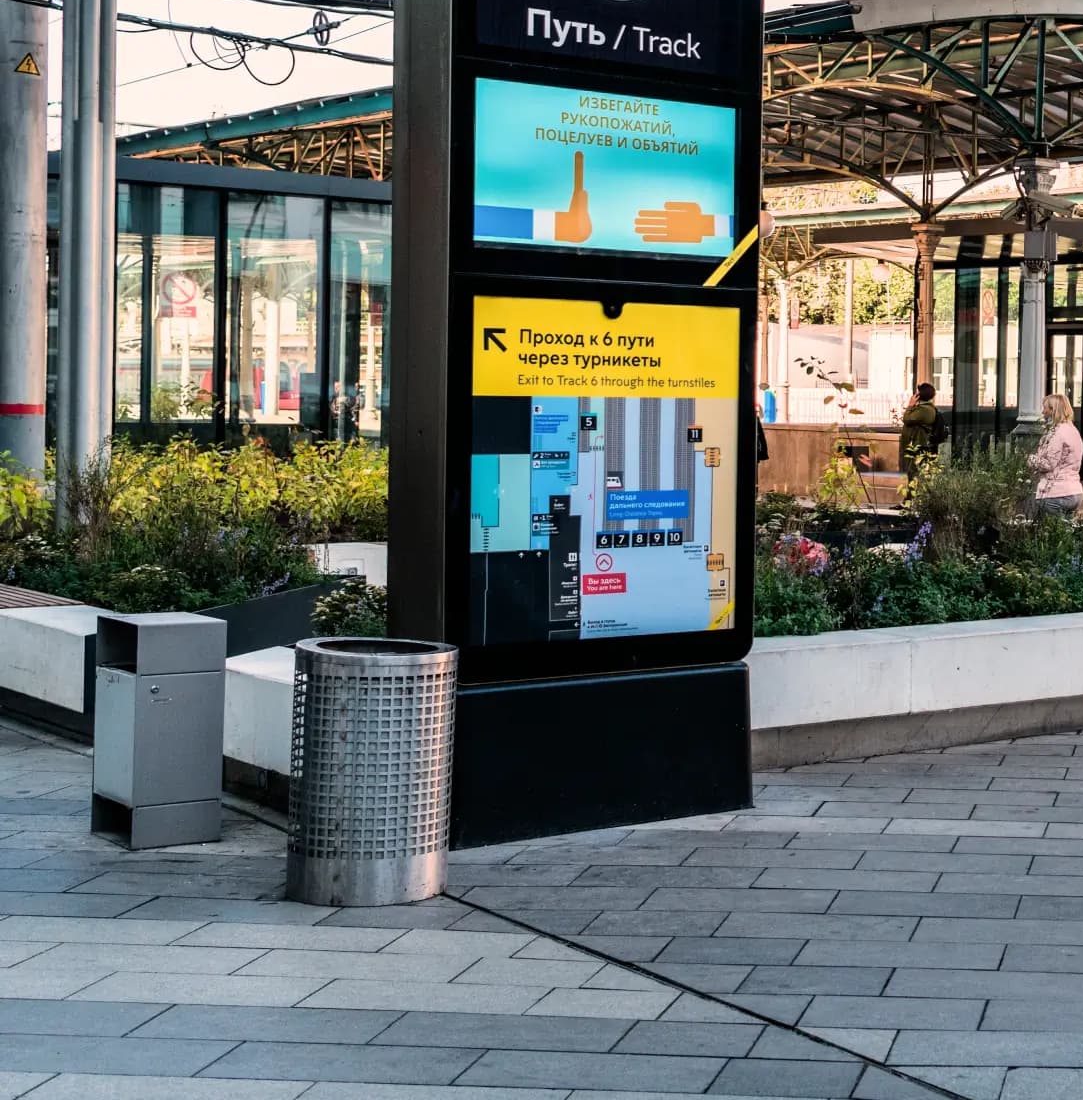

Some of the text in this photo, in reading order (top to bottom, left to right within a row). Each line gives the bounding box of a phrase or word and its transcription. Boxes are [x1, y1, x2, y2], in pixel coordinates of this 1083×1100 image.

[527, 7, 701, 59] Путь / Track
[579, 96, 660, 116] ИЗБЕГАЙТЕ
[561, 112, 676, 137] РУКОПОЖАТИЙ,
[535, 128, 699, 156] ПОЦЕЛУЕВ И ОБЪЯТИЙ
[519, 328, 655, 350] Проход к 6 пути
[518, 353, 661, 370] через турникеты
[517, 374, 716, 390] Exit to Track 6 through the turnstiles
[585, 417, 593, 427] 5
[690, 429, 699, 438] 11
[610, 493, 637, 501] Поезда
[644, 500, 686, 509] следования
[600, 535, 608, 545] 6
[618, 534, 625, 544] 7
[636, 534, 643, 543] 8
[653, 533, 661, 543] 9
[670, 532, 681, 541] 10
